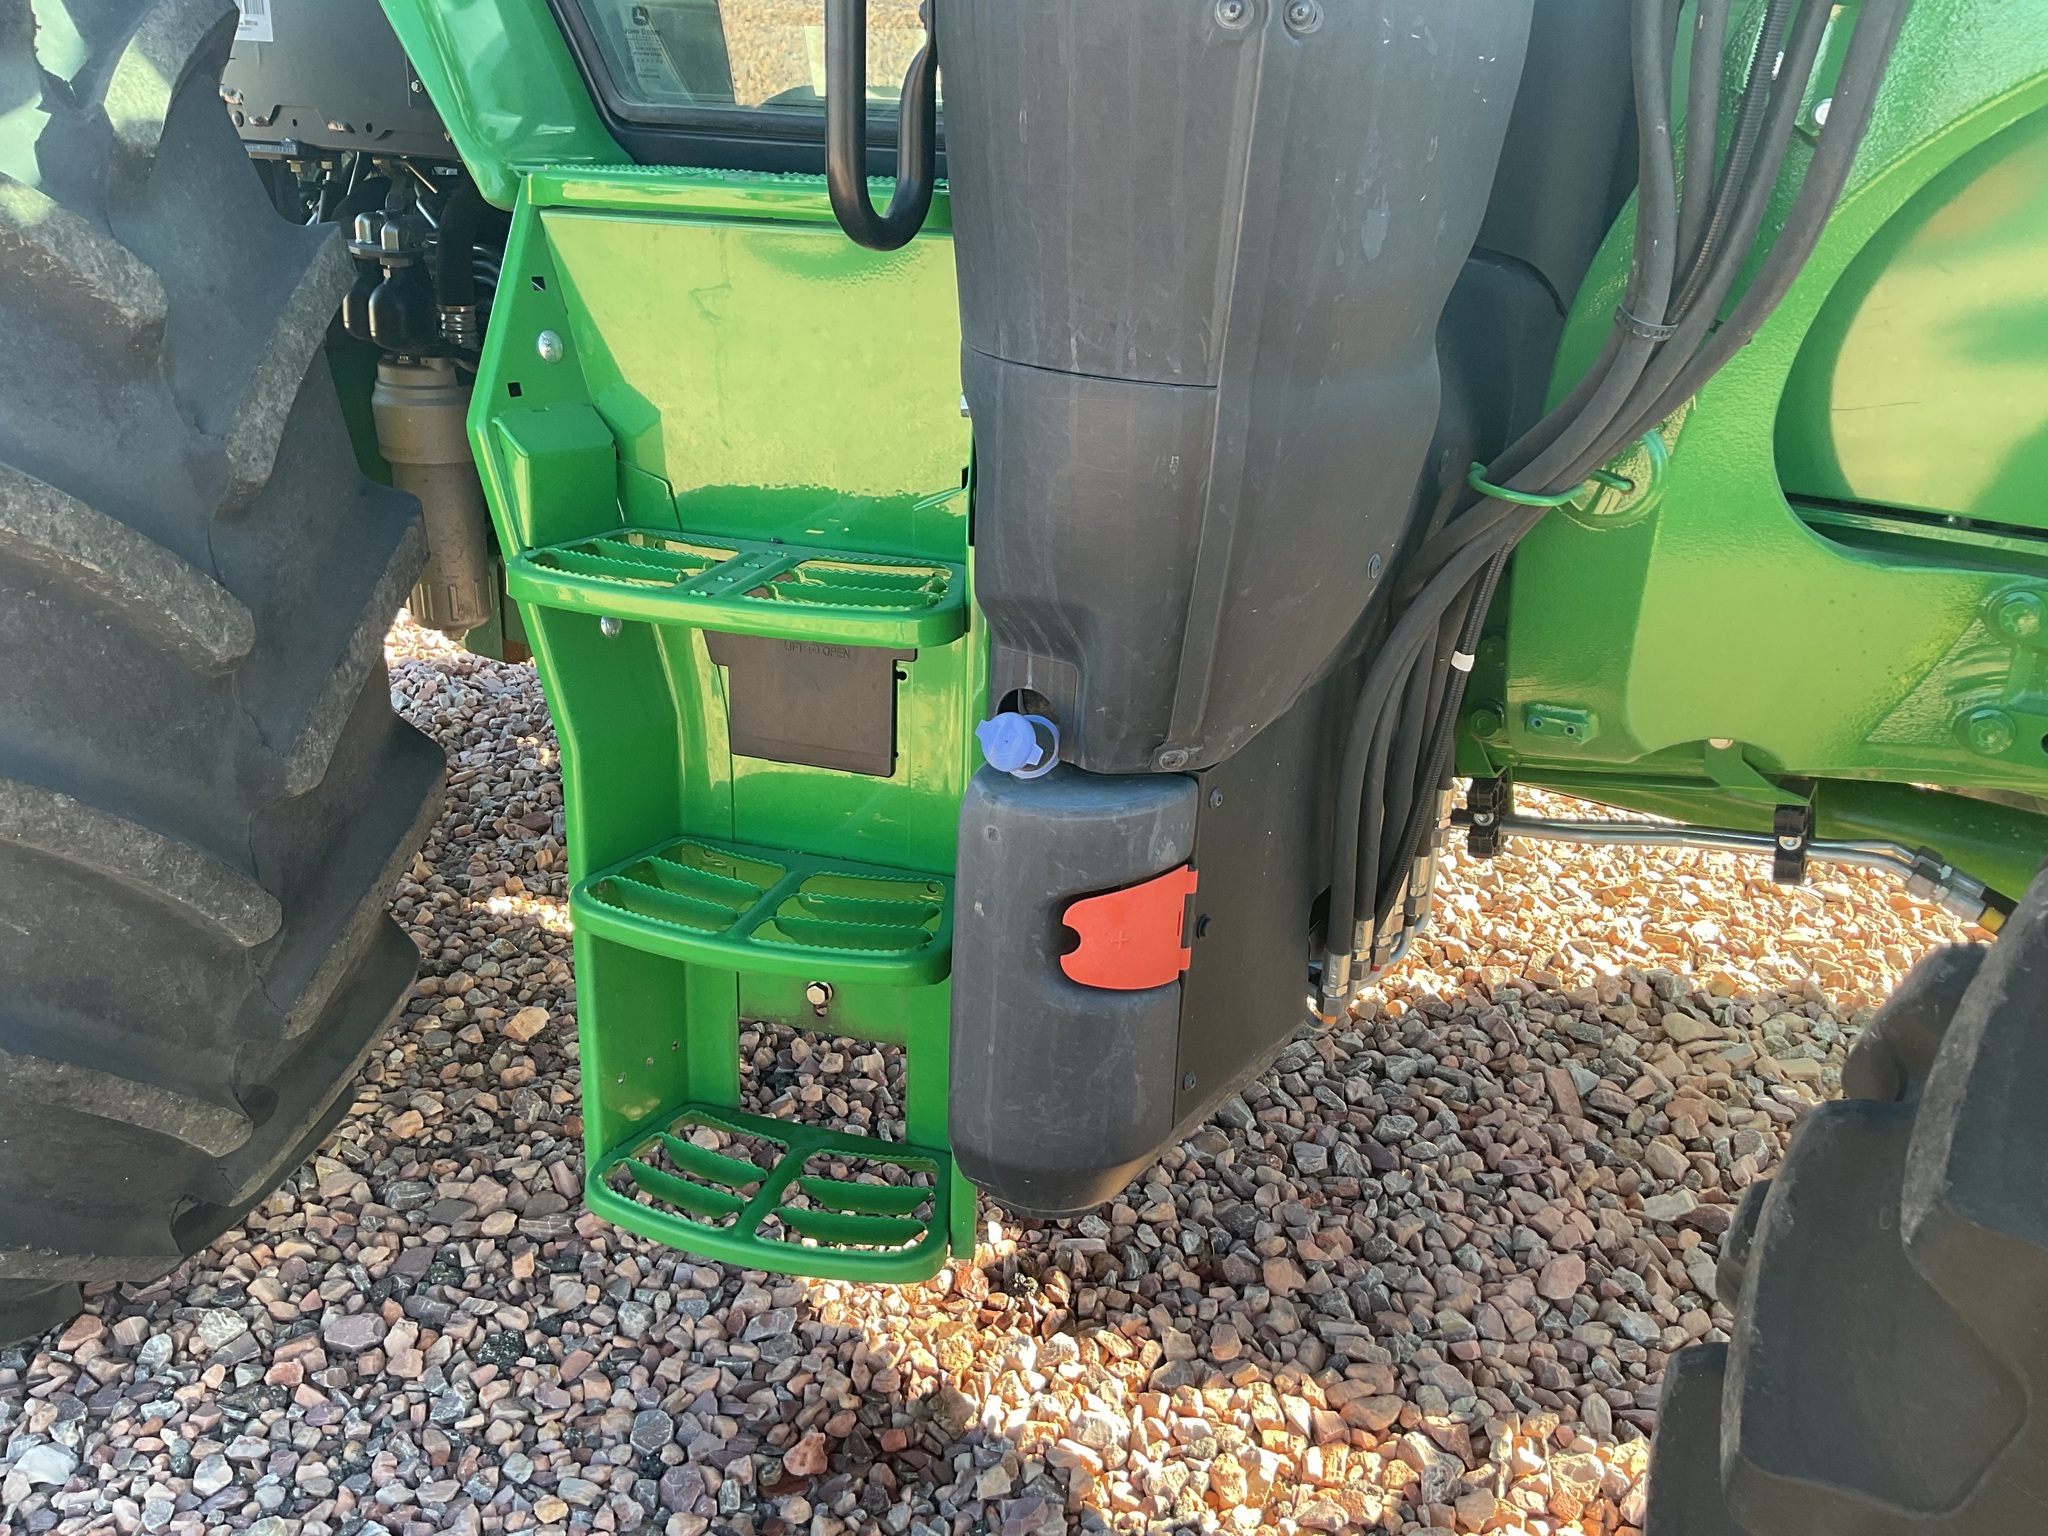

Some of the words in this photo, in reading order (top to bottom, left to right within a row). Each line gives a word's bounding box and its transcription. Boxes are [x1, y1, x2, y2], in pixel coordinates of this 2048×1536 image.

[784, 640, 802, 653] LIFT
[807, 643, 819, 655] TO
[822, 646, 851, 659] OPEN
